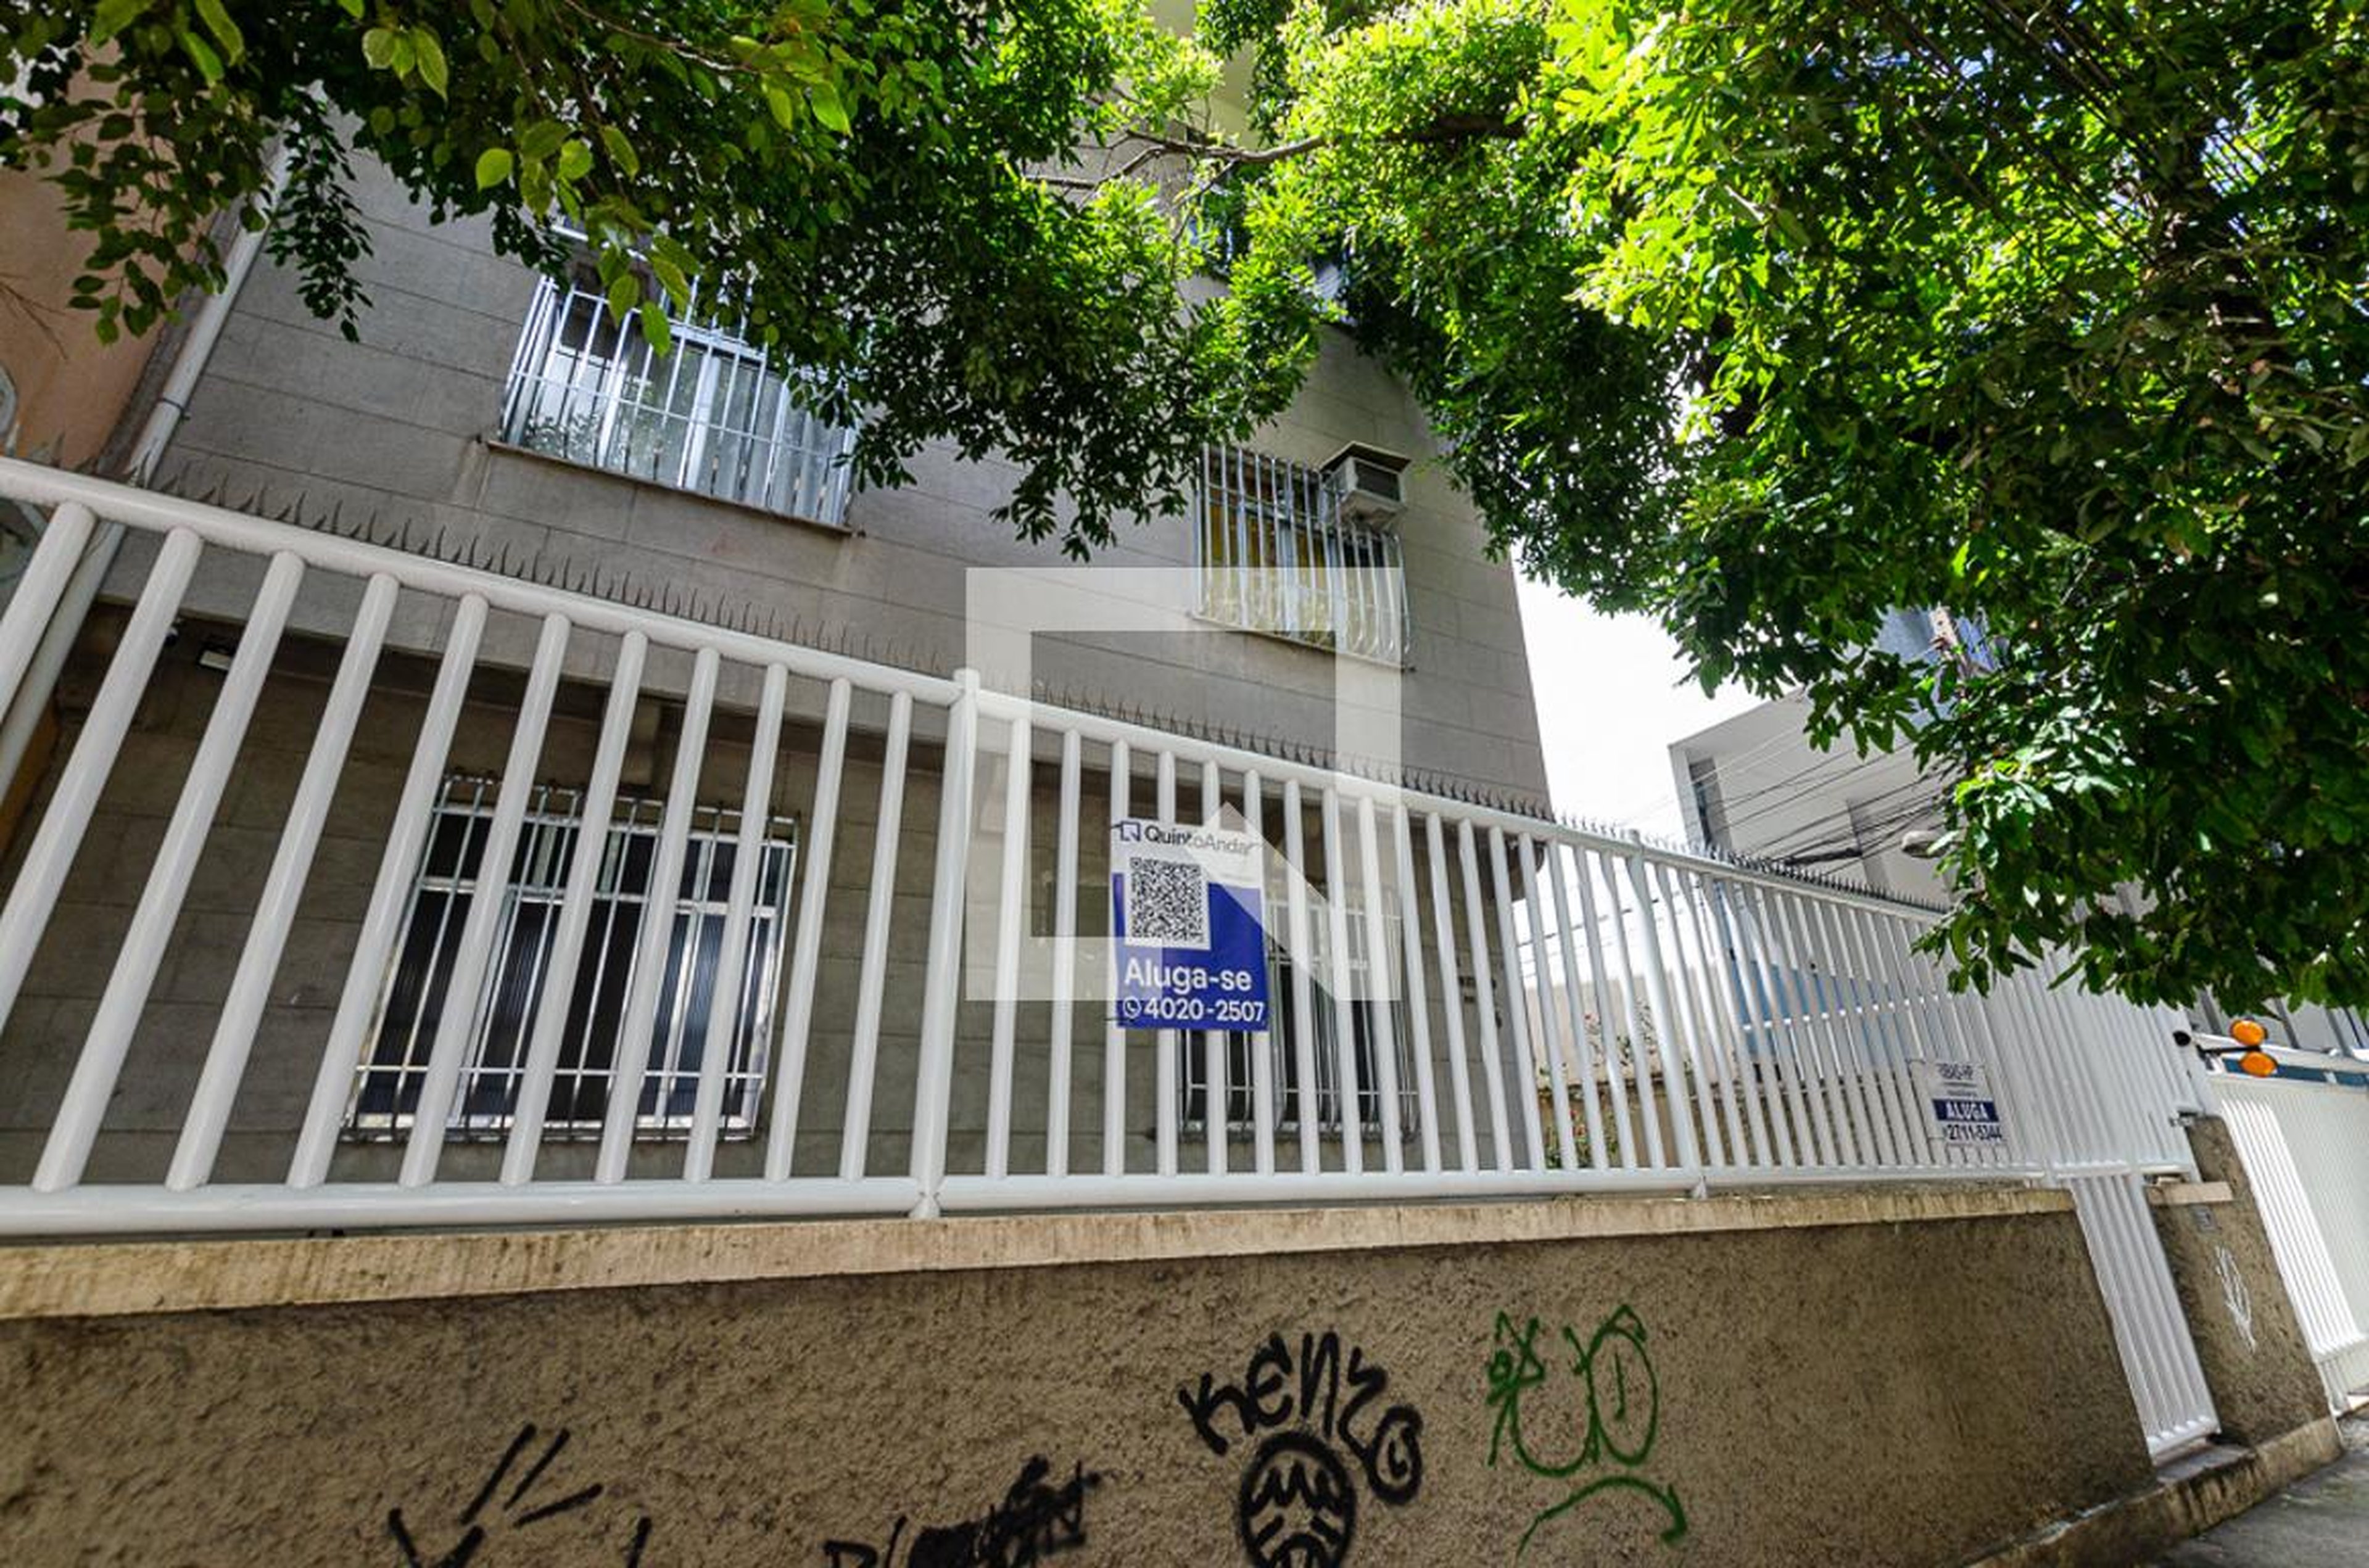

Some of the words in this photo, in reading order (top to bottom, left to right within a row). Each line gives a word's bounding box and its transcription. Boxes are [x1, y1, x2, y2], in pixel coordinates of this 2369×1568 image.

[1124, 957, 1253, 994] Aluga-se
[1144, 997, 1265, 1022] 4020-2507
[1945, 1101, 1989, 1120] ALUGA
